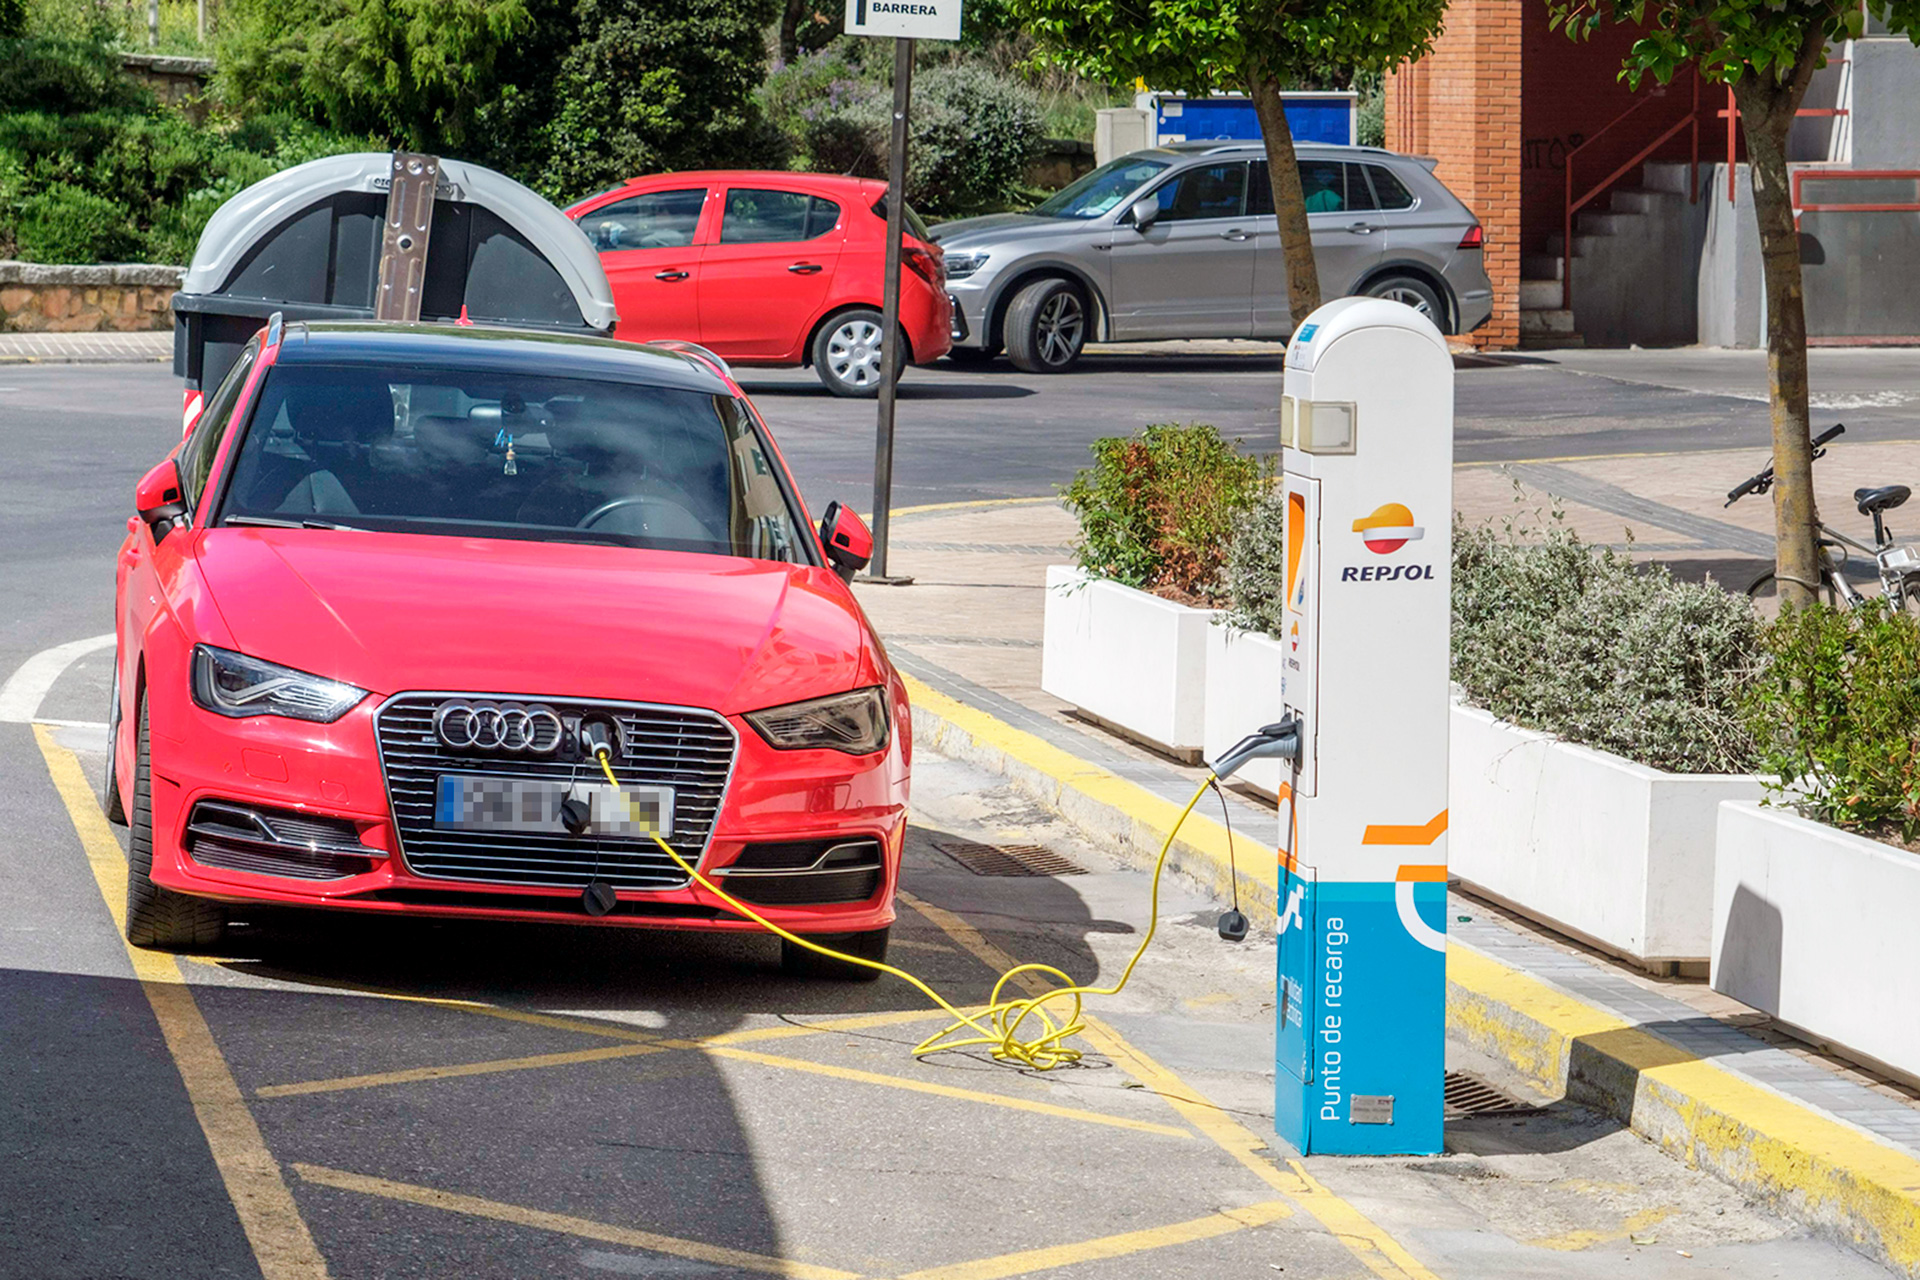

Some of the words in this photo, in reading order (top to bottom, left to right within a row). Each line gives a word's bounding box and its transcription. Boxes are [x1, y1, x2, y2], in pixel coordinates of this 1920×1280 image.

[872, 2, 937, 16] BARRERA
[1341, 564, 1435, 582] REPSOL
[1325, 916, 1349, 1007] recarga
[1319, 1015, 1342, 1044] de
[1320, 1051, 1342, 1121] Punto
